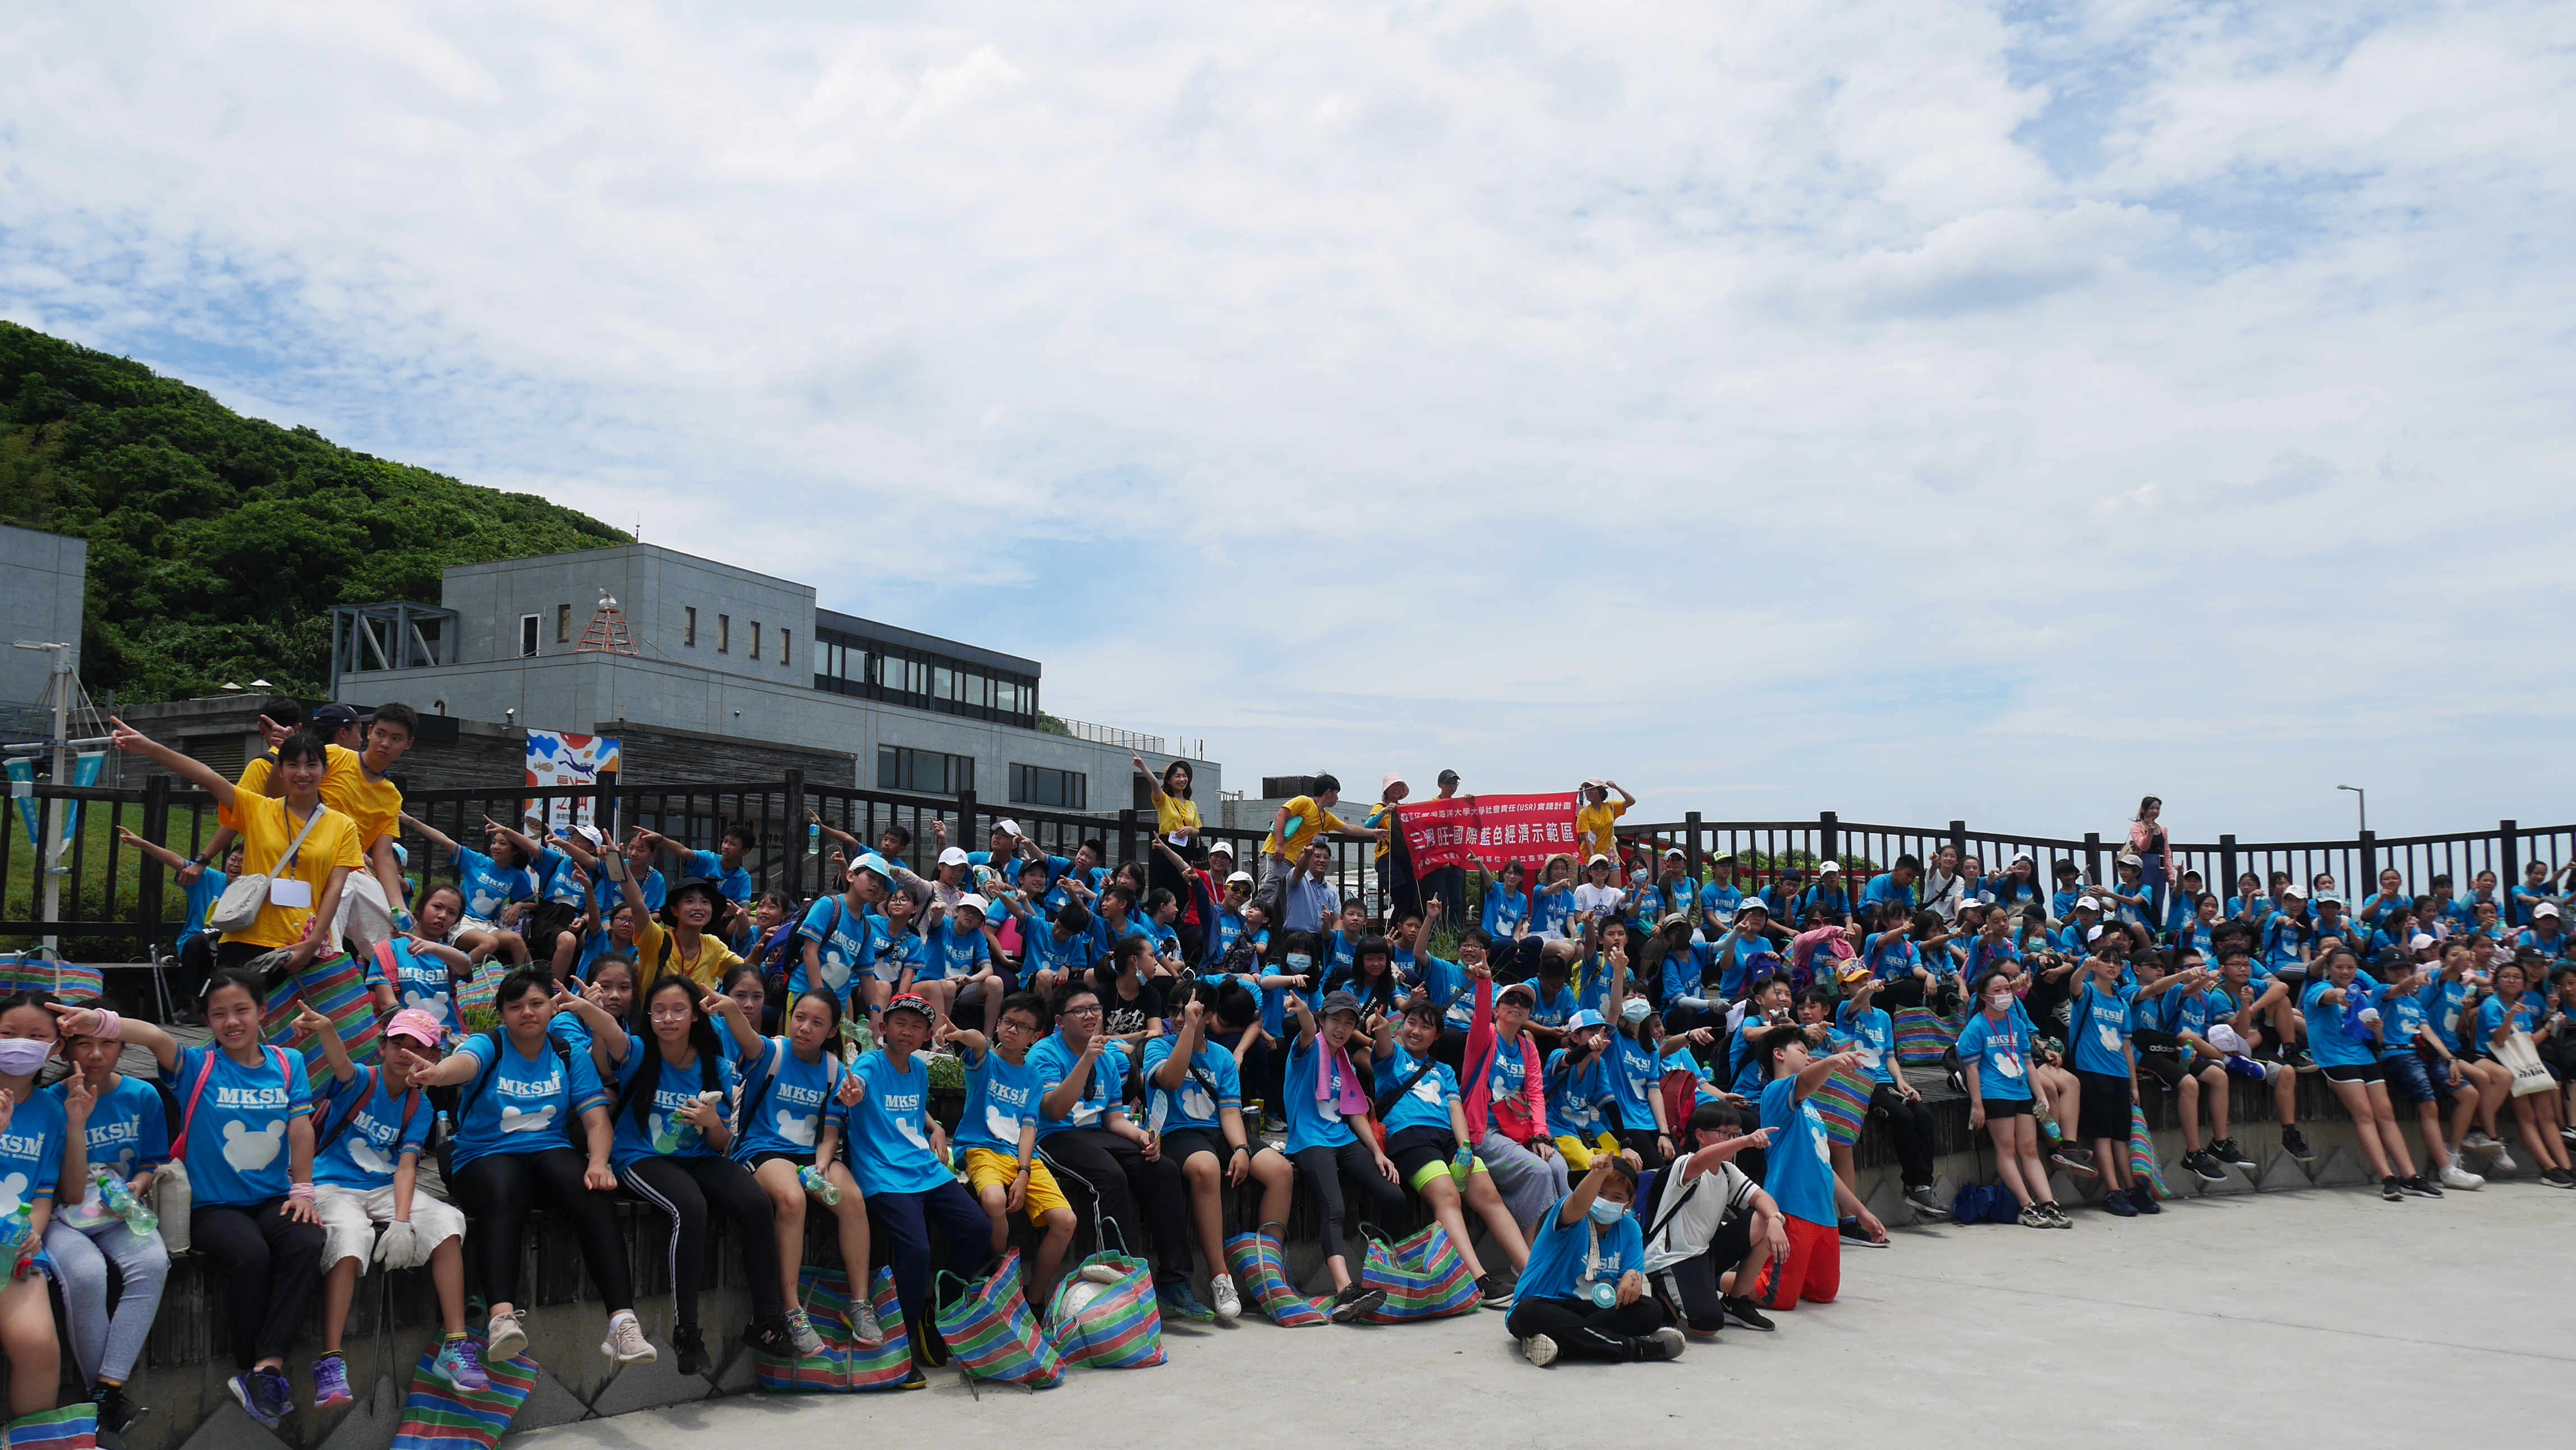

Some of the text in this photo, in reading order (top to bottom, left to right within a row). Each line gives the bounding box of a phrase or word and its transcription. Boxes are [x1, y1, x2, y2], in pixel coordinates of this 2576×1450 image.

[899, 1000, 923, 1009] NIKE
[2150, 1045, 2175, 1053] adidas
[498, 1076, 561, 1094] MKSM
